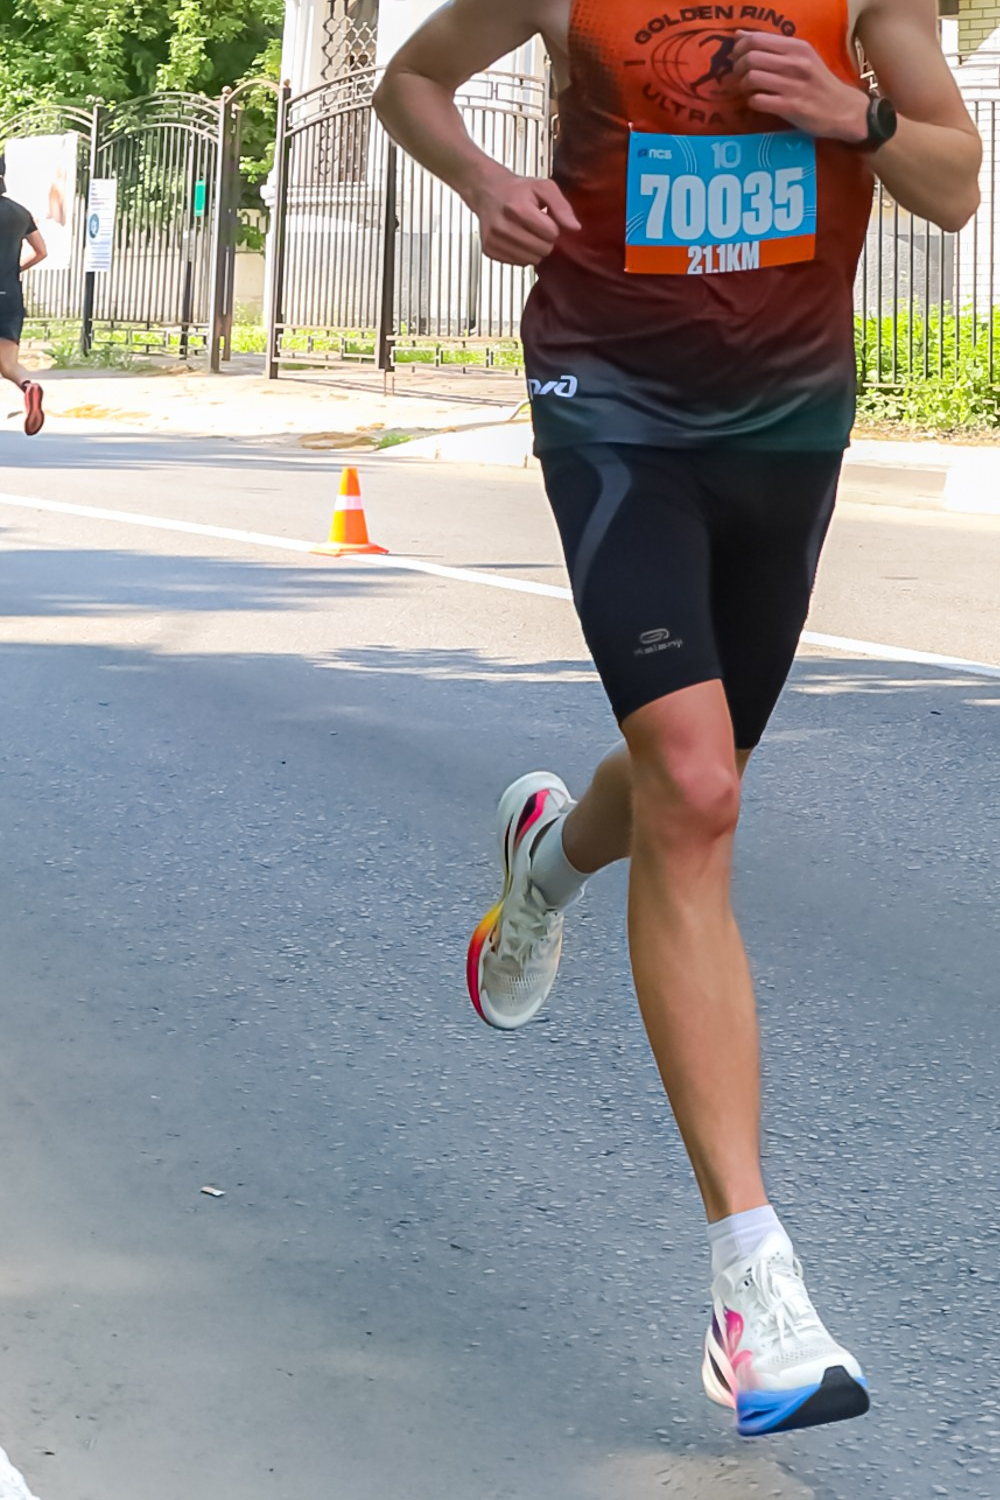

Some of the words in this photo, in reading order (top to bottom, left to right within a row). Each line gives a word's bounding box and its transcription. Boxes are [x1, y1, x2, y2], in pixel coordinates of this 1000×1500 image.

[634, 5, 734, 45] GOLDEN
[740, 5, 797, 37] RING
[643, 83, 725, 125] ULTRA
[711, 140, 742, 169] 10
[640, 167, 804, 240] 70035
[687, 241, 760, 275] 21.1KM
